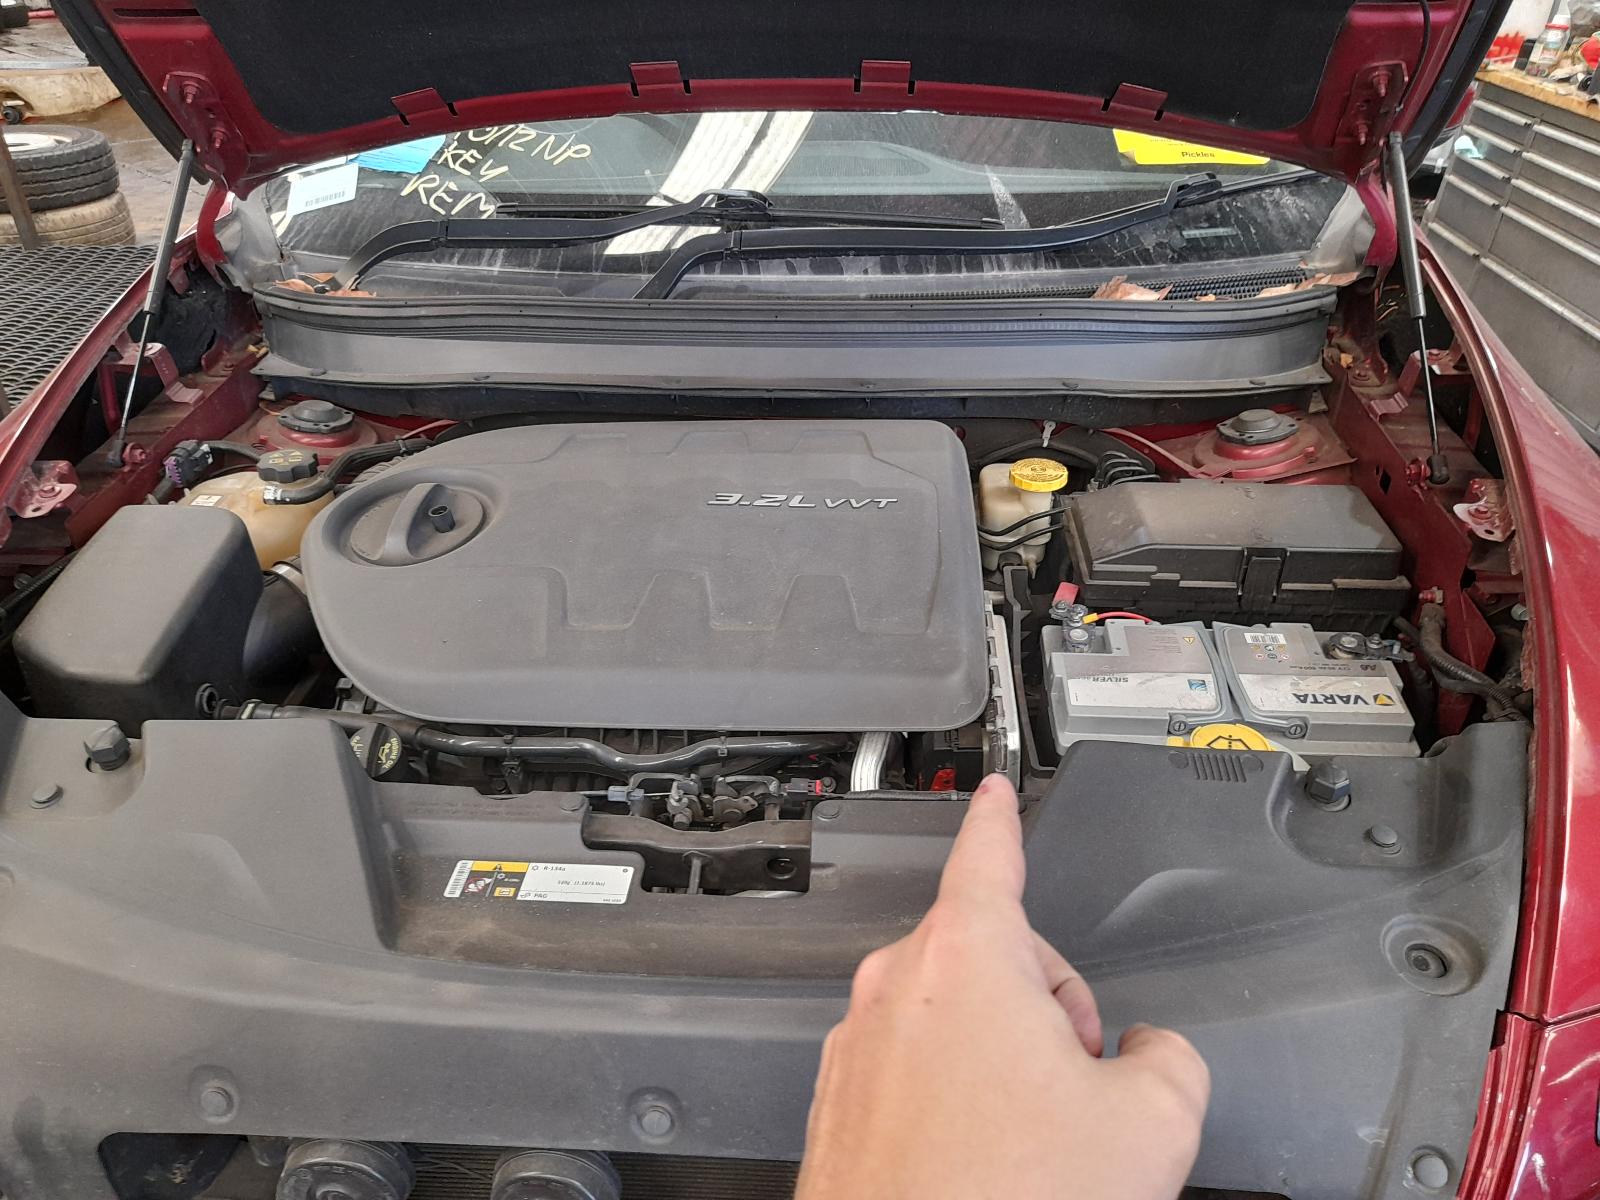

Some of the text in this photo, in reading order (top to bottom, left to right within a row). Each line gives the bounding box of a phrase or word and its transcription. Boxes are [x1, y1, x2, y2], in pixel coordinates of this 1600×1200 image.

[531, 134, 592, 166] NP
[437, 141, 509, 183] KEY
[707, 492, 898, 508] 3.2L VVT
[1092, 675, 1129, 683] SILVER
[1291, 692, 1370, 706] VARTA
[390, 737, 399, 760] ENGINE
